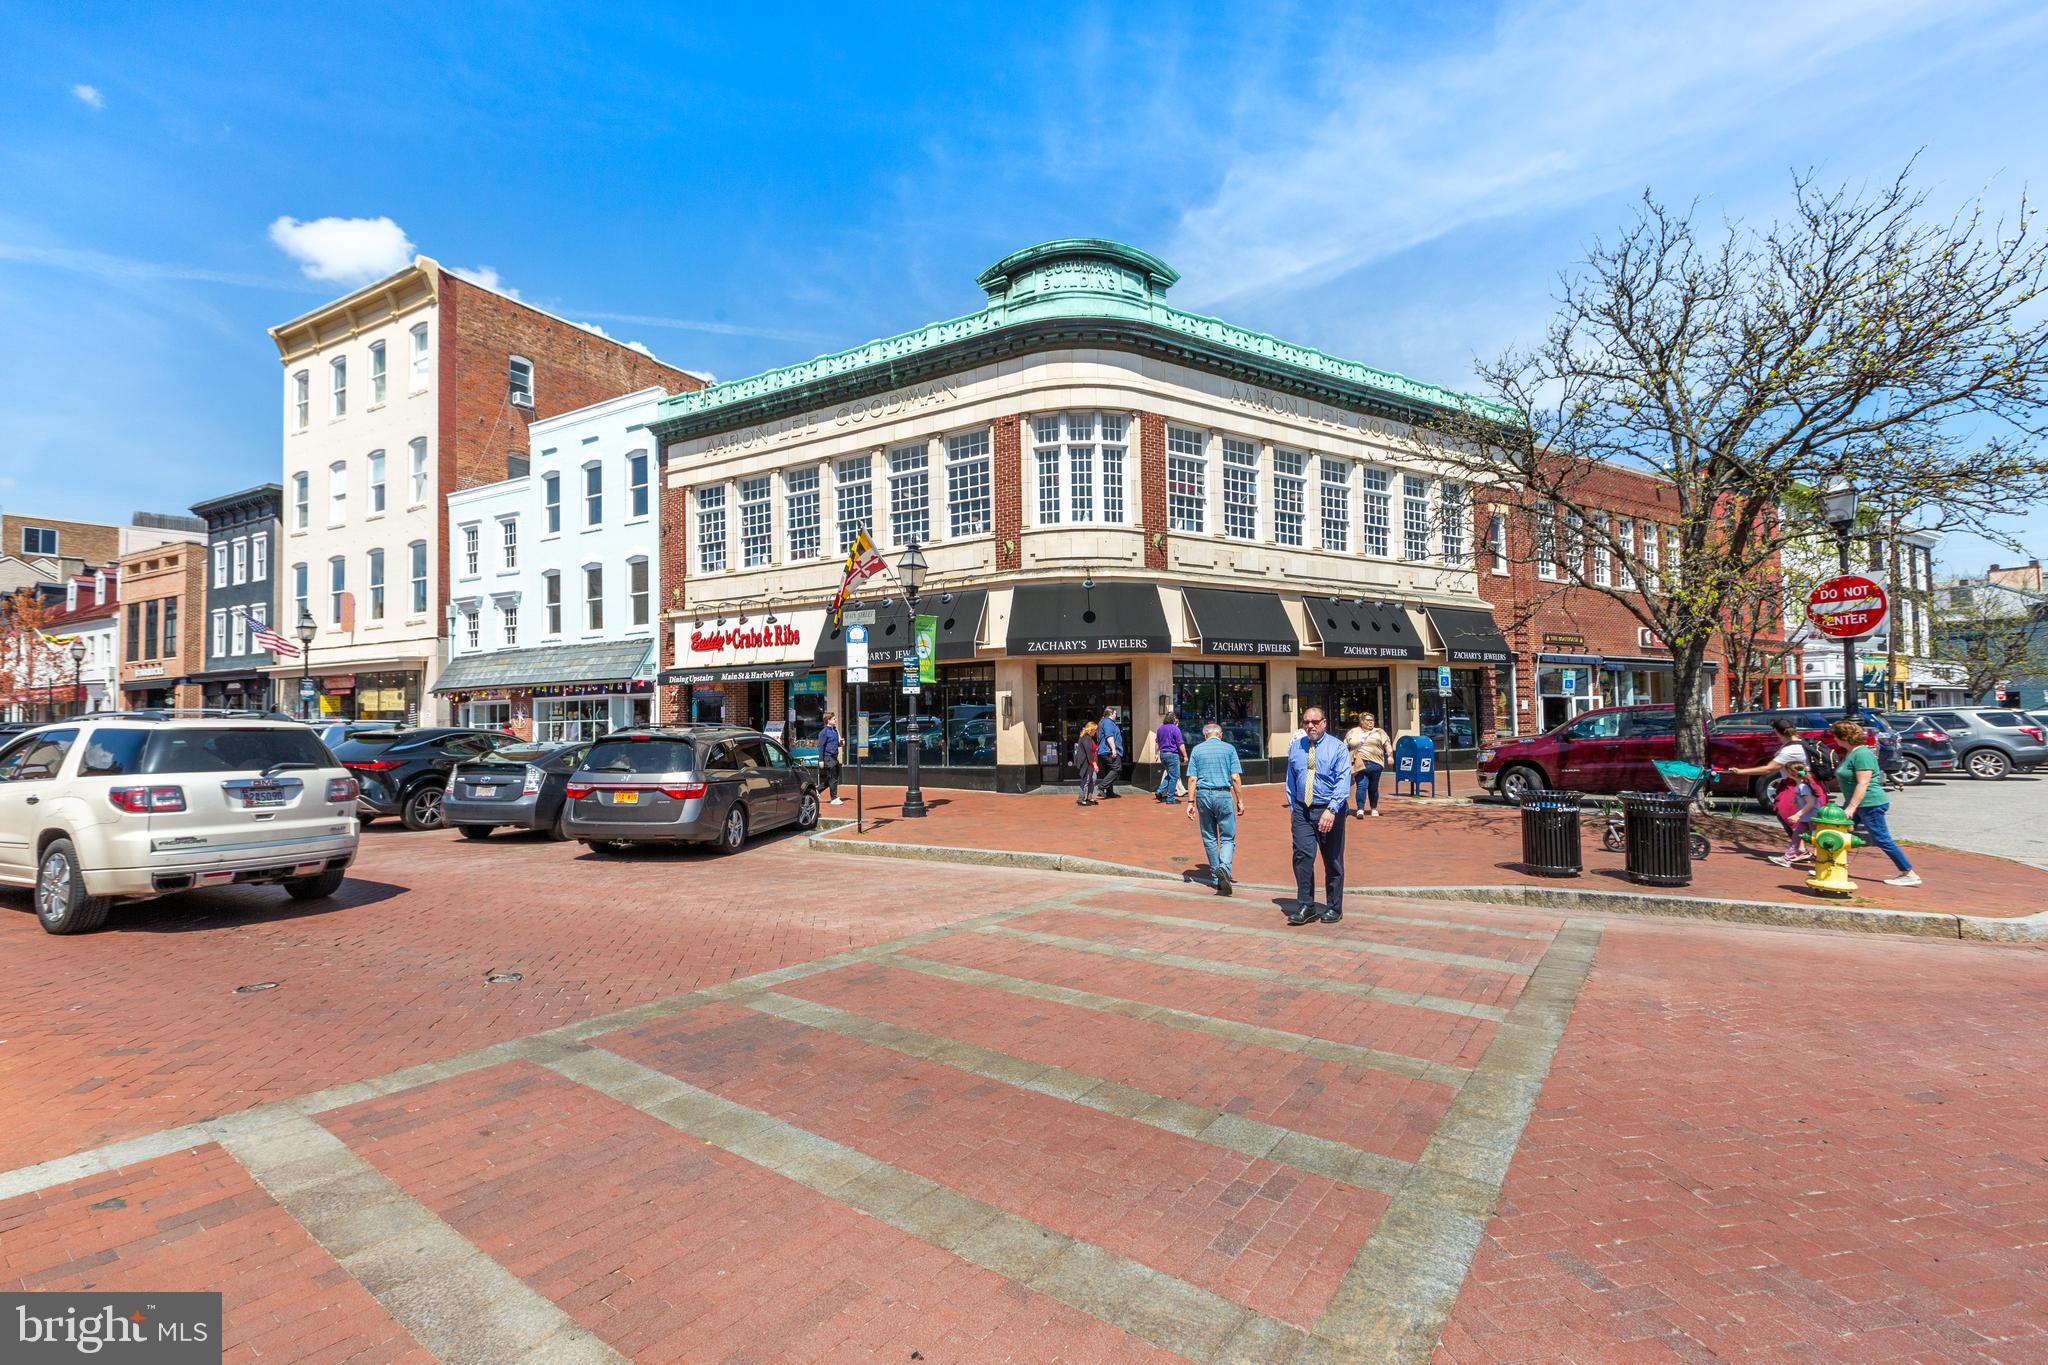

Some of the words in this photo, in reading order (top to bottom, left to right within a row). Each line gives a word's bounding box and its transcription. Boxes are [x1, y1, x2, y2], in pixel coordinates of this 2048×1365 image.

[1045, 261, 1113, 277] GOODMAN
[1043, 276, 1115, 291] BUILDING
[1230, 384, 1299, 418] AARON
[1307, 403, 1348, 431] LEE
[704, 425, 769, 458] AARON
[778, 413, 819, 441] LEE
[834, 377, 958, 426] GOODMAN
[1820, 589, 1838, 600] DO
[1843, 586, 1869, 597] NOT
[857, 610, 875, 618] STREET
[691, 630, 732, 652] Buddy's
[732, 627, 762, 649] Crabs
[763, 625, 773, 647] &
[774, 624, 800, 646] Ribs
[1027, 640, 1087, 652] ZACHARY'S
[1097, 639, 1148, 650] JEWELERS
[1212, 641, 1254, 652] ZACHARY'S
[1257, 643, 1291, 653] JEWELERS
[1343, 646, 1377, 655] ZACHARY'S
[1380, 648, 1408, 656] JEWELERS
[1453, 651, 1481, 660] ZACHARY'S
[669, 676, 689, 684] Dining
[689, 674, 714, 683] Upstairs
[721, 673, 737, 681] Main
[737, 672, 745, 680] St
[745, 672, 750, 680] &
[751, 671, 774, 679] Harbor
